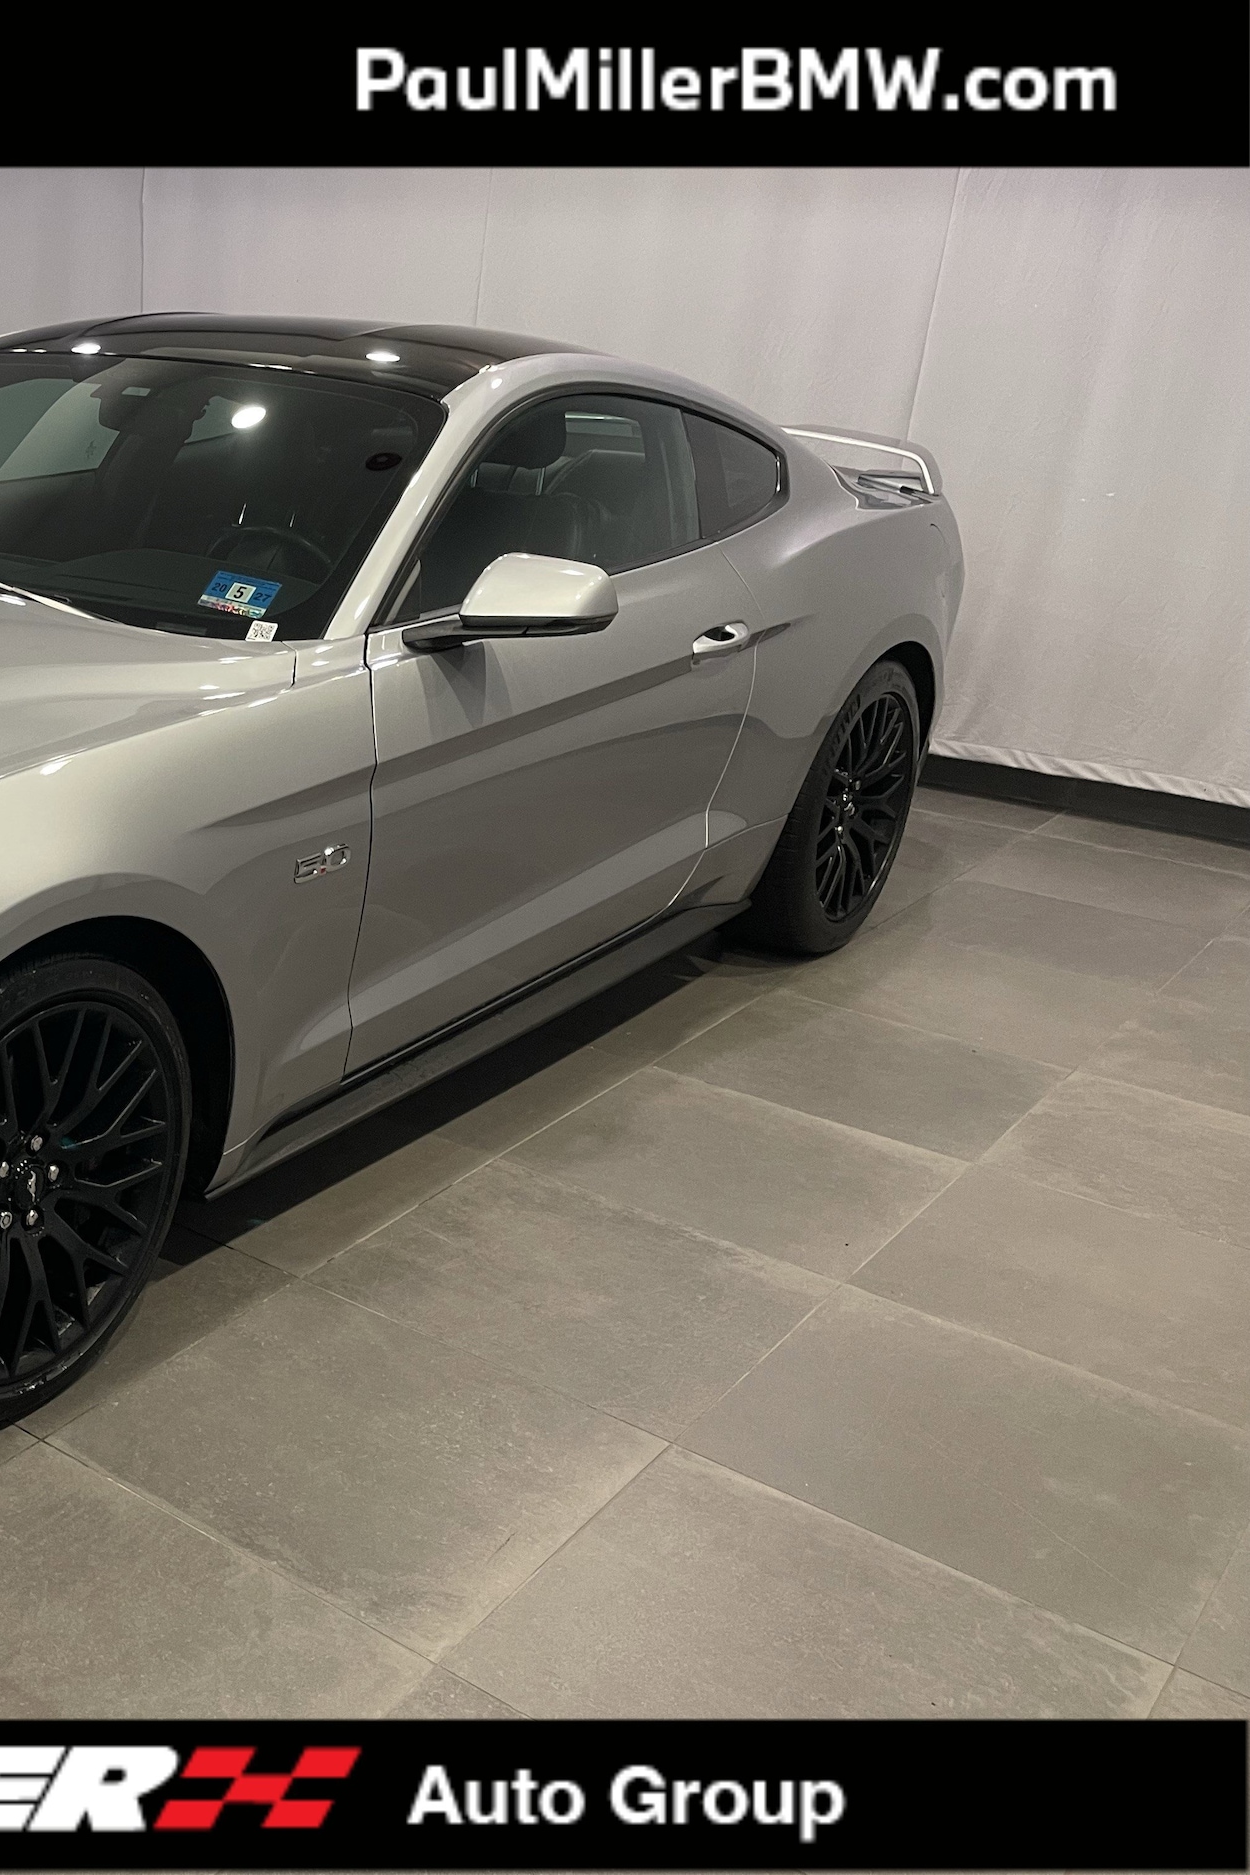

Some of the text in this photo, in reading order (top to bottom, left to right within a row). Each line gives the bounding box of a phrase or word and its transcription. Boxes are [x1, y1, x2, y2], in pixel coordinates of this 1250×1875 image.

[212, 583, 271, 603] 20 5 27
[293, 843, 352, 884] 5.0
